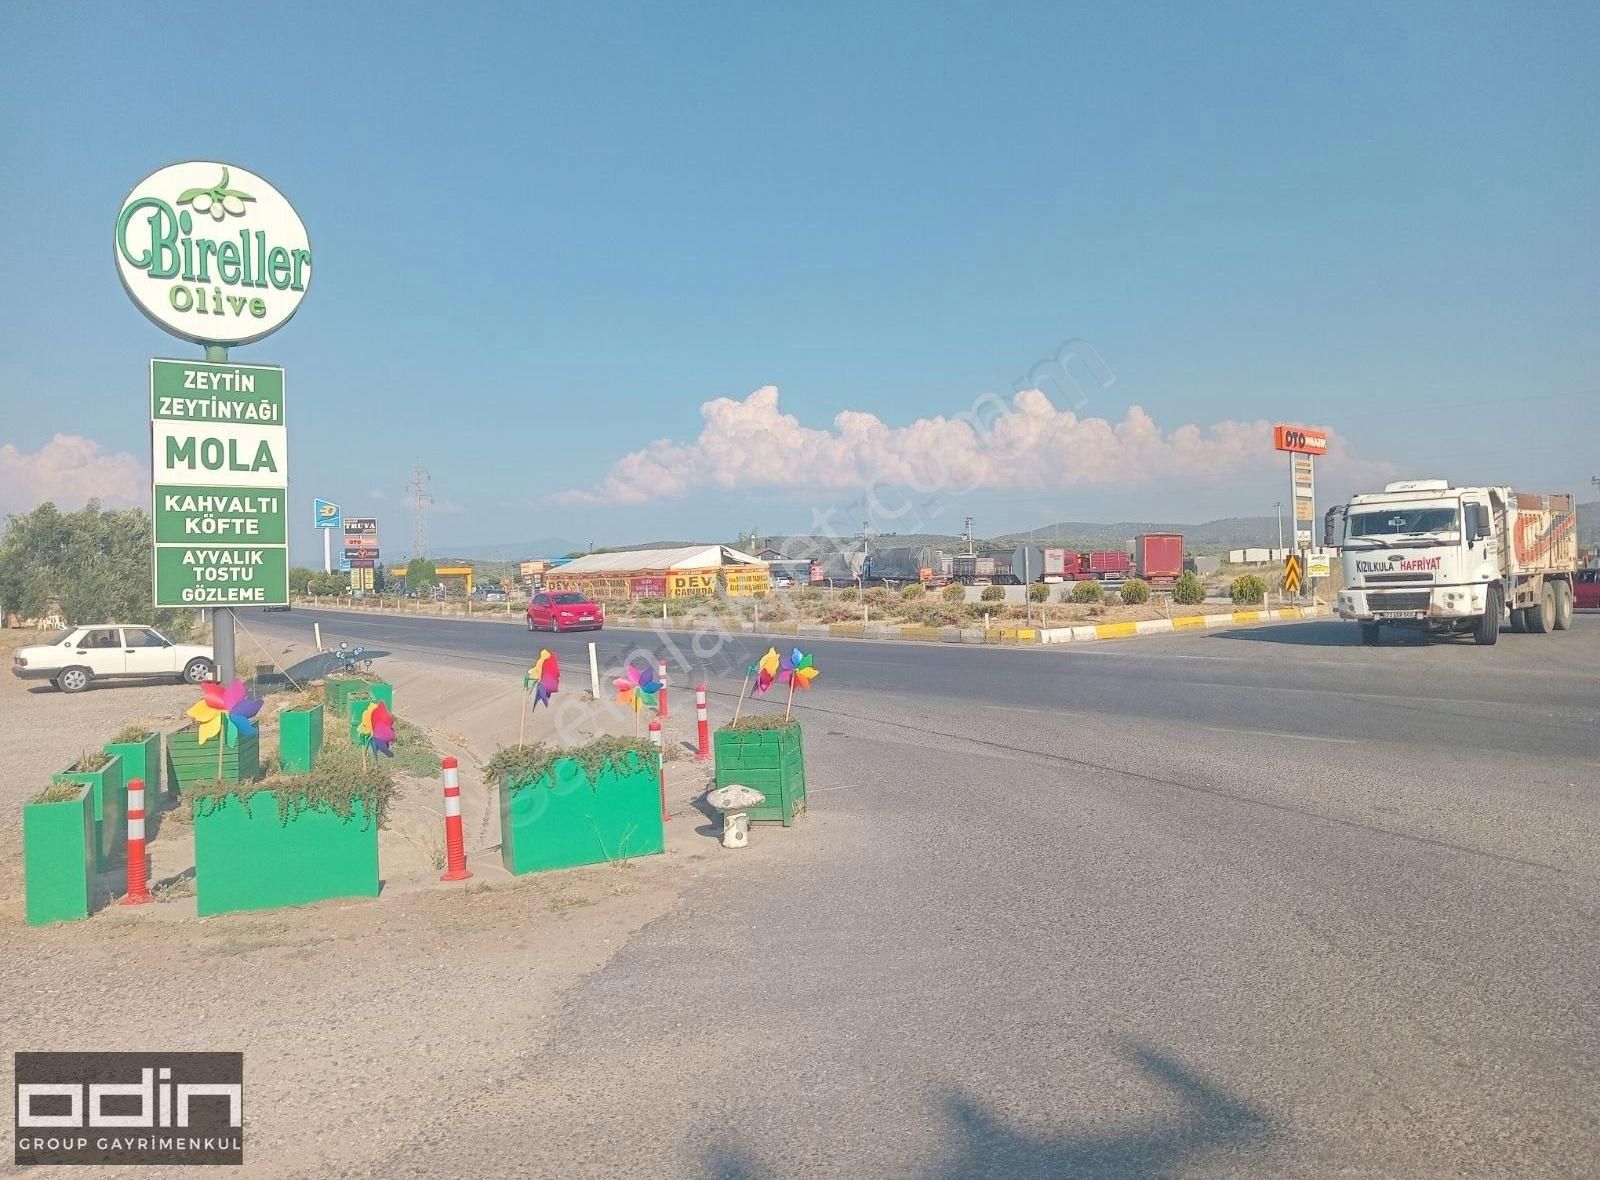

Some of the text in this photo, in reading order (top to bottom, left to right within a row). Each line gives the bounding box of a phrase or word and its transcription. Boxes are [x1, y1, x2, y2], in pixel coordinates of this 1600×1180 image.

[117, 197, 311, 291] Bireller
[169, 285, 266, 318] Olive
[184, 369, 255, 393] ZEYTİN
[159, 396, 278, 421] ZEYTİNYAĞI
[166, 435, 278, 473] MOLA
[164, 495, 279, 513] KAHVALTI
[185, 513, 259, 535] KÖFTE
[182, 550, 264, 565] AYVALIK
[1356, 560, 1394, 573] KIZILKULA
[1400, 556, 1442, 571] HAFRİYAT
[192, 566, 253, 582] TOSTU
[675, 576, 712, 588] DEV
[181, 584, 265, 602] GÖZLEME
